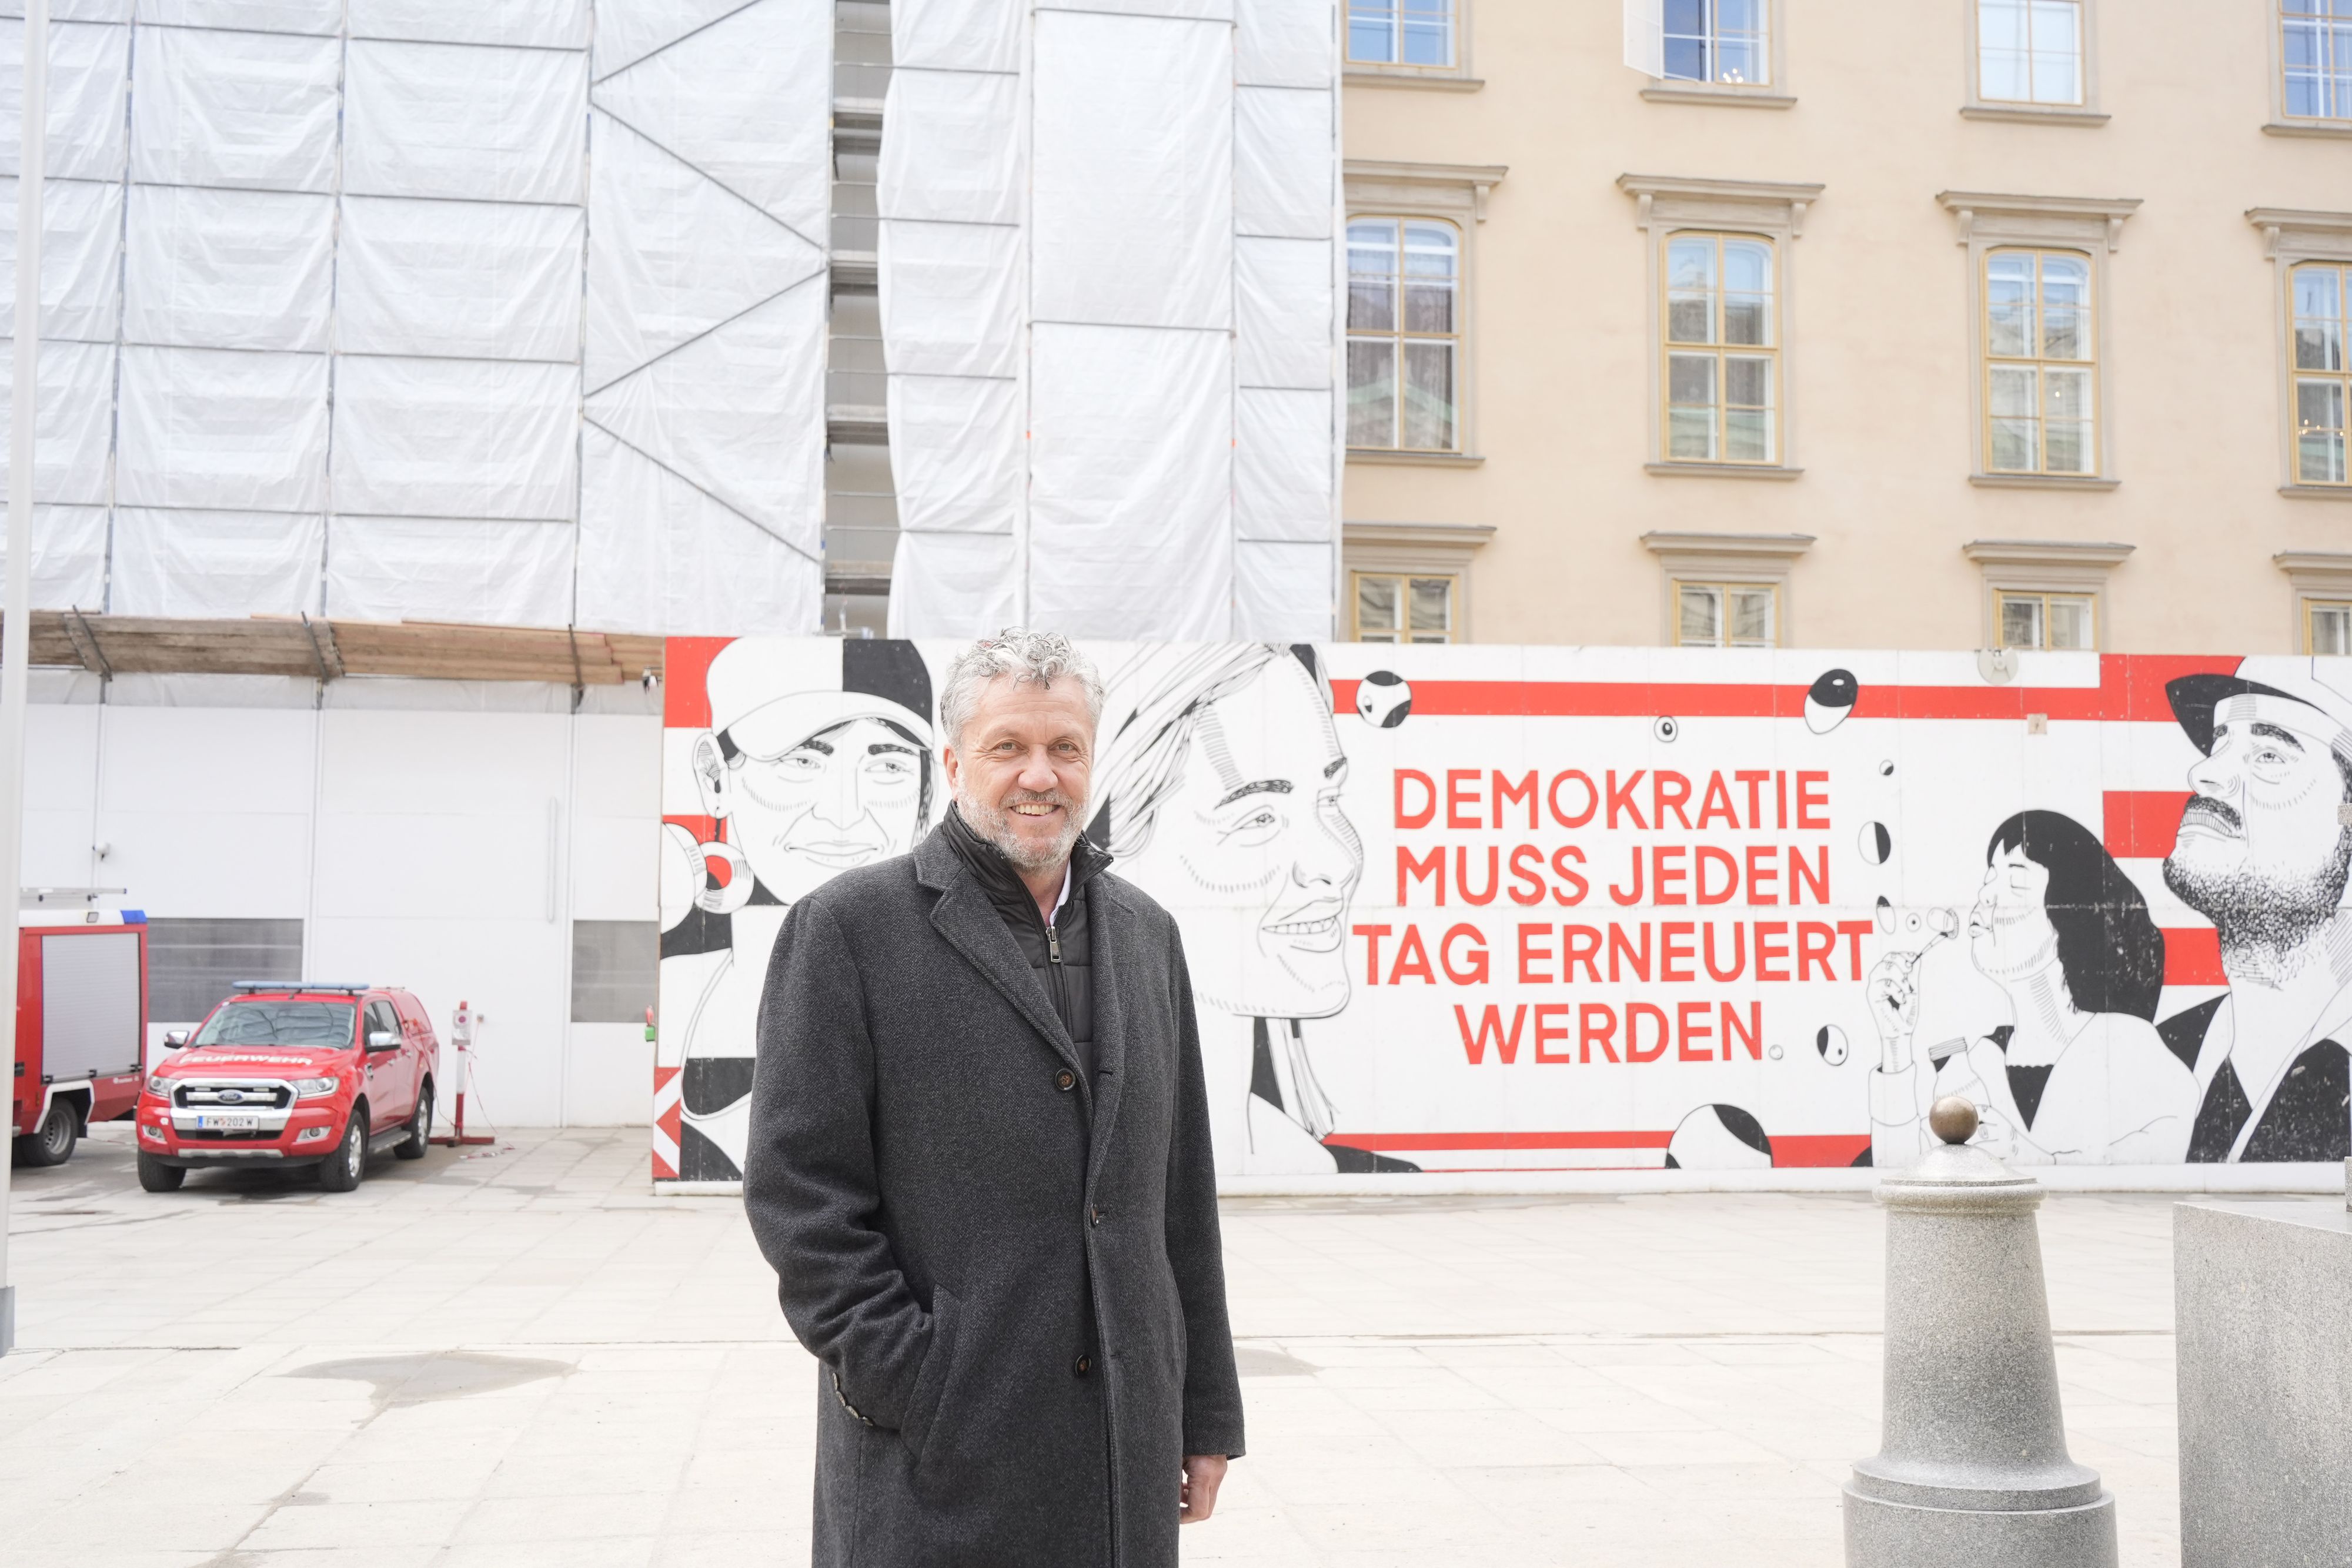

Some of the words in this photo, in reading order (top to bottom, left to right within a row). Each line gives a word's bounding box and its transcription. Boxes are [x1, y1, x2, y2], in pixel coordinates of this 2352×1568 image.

[1394, 768, 1831, 830] DEMOKRATIE
[1397, 844, 1590, 907] MUSS
[1609, 845, 1830, 906] JEDEN
[1352, 922, 1490, 986] TAG
[1518, 920, 1874, 984] ERNEUERT
[179, 1054, 313, 1066] FEUERWEHR
[1454, 1001, 1763, 1065] WERDEN
